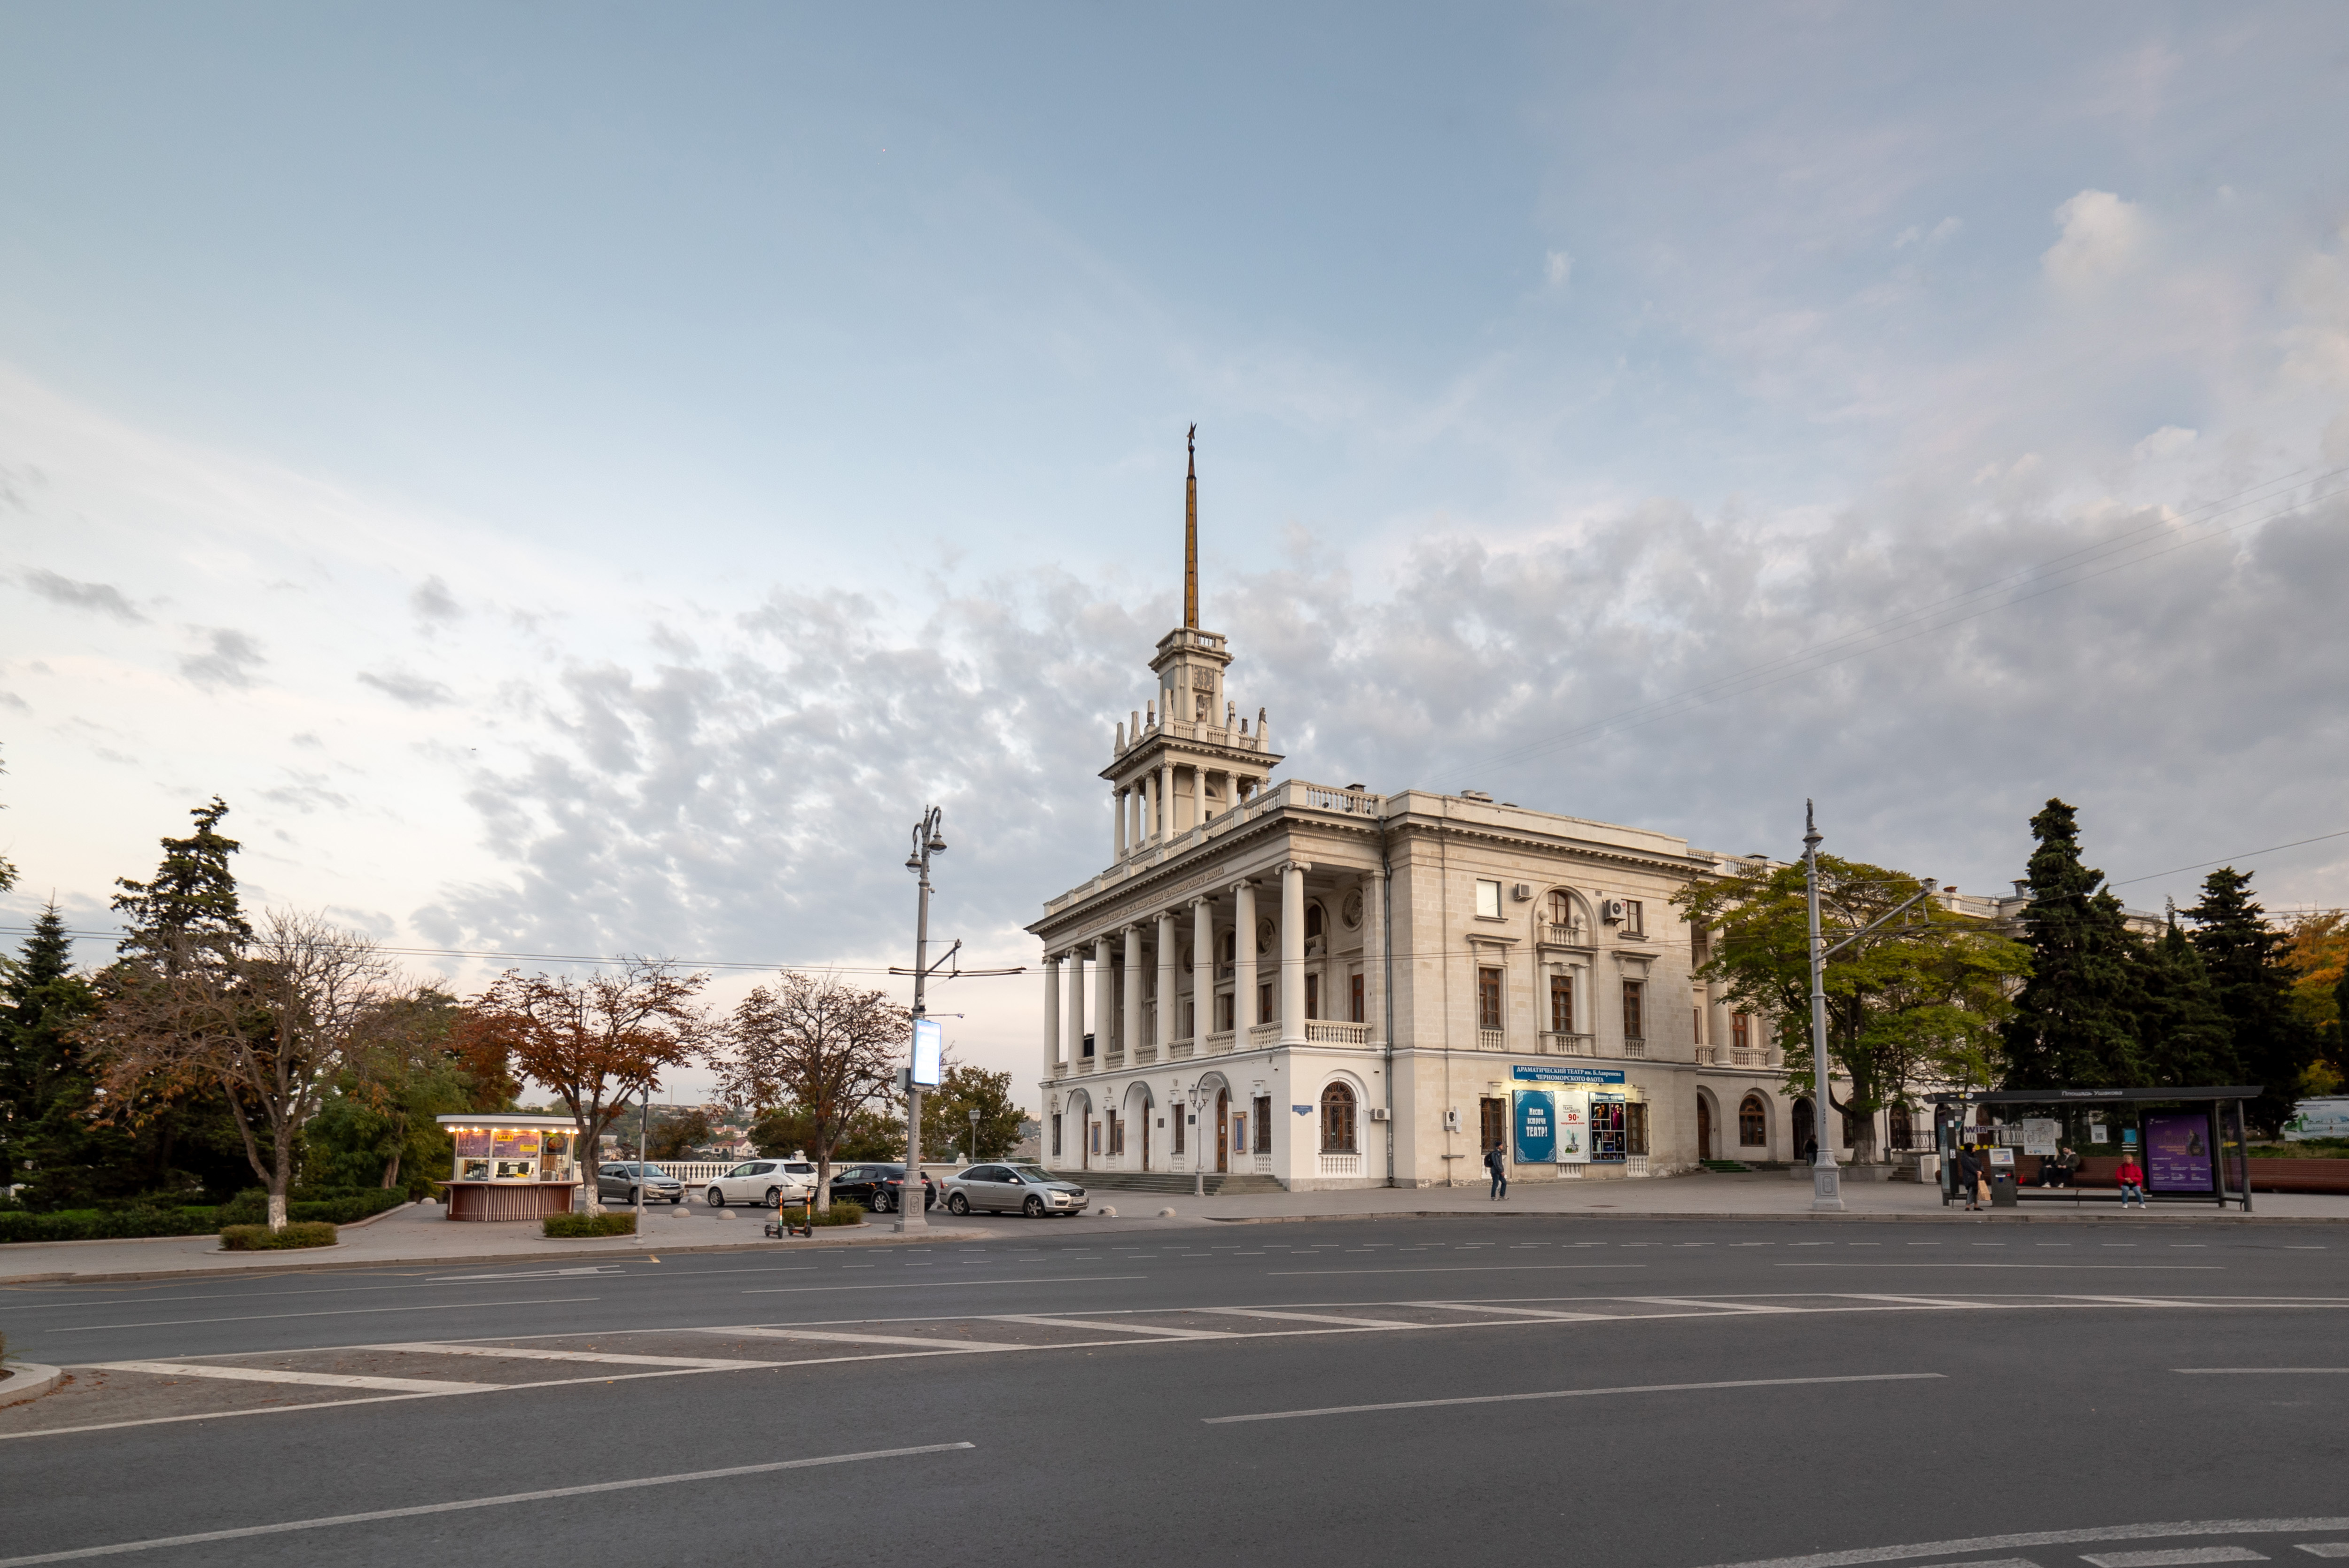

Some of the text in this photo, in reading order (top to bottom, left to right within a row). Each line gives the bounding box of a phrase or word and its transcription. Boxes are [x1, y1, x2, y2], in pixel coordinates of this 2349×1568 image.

[1109, 910, 1121, 921] ТЕАТР
[1163, 875, 1205, 899] ЧЕРНОМОРСКОГО
[1205, 866, 1224, 881] ФЛОТА
[1526, 1126, 1548, 1137] ТЕАТР!
[1965, 1124, 1986, 1133] win
